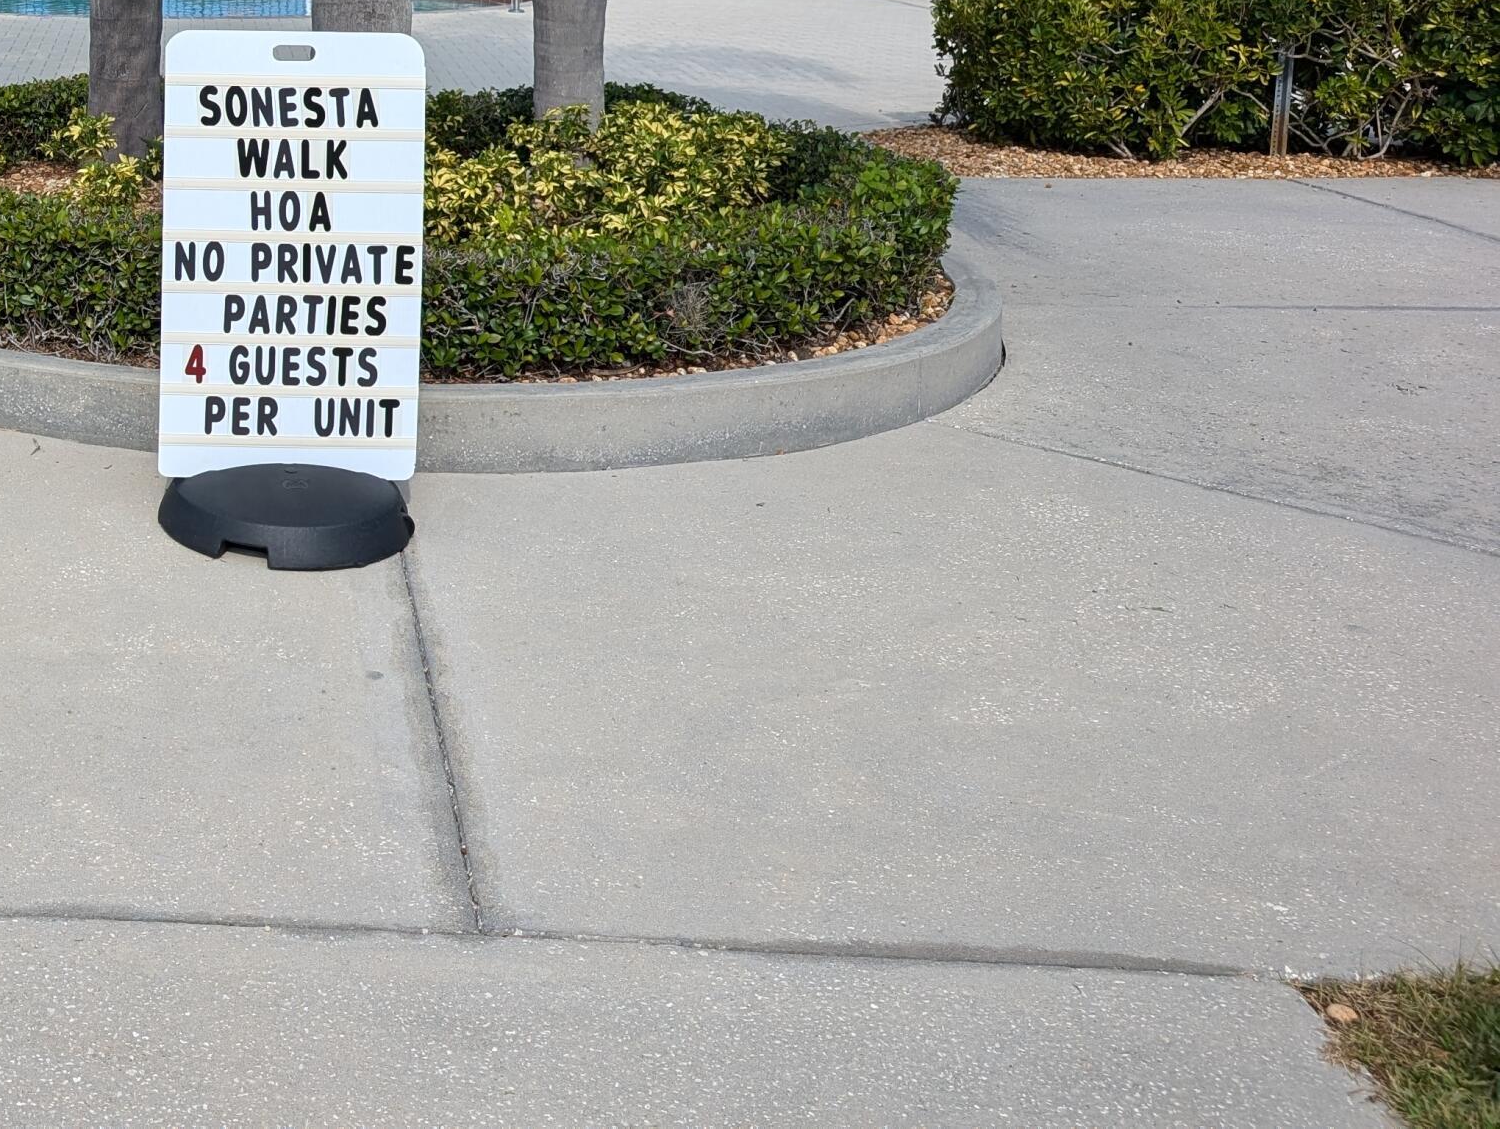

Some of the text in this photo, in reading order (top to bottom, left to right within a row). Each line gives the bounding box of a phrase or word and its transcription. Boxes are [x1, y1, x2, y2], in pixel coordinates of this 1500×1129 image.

[200, 86, 378, 128] SONESTA
[238, 138, 347, 179] WALK
[251, 191, 331, 231] HOA
[176, 242, 415, 284] NO PRIVATE
[224, 295, 386, 336] PARTIES
[185, 344, 377, 386] 4 GUESTS
[205, 396, 400, 437] PER UNIT
